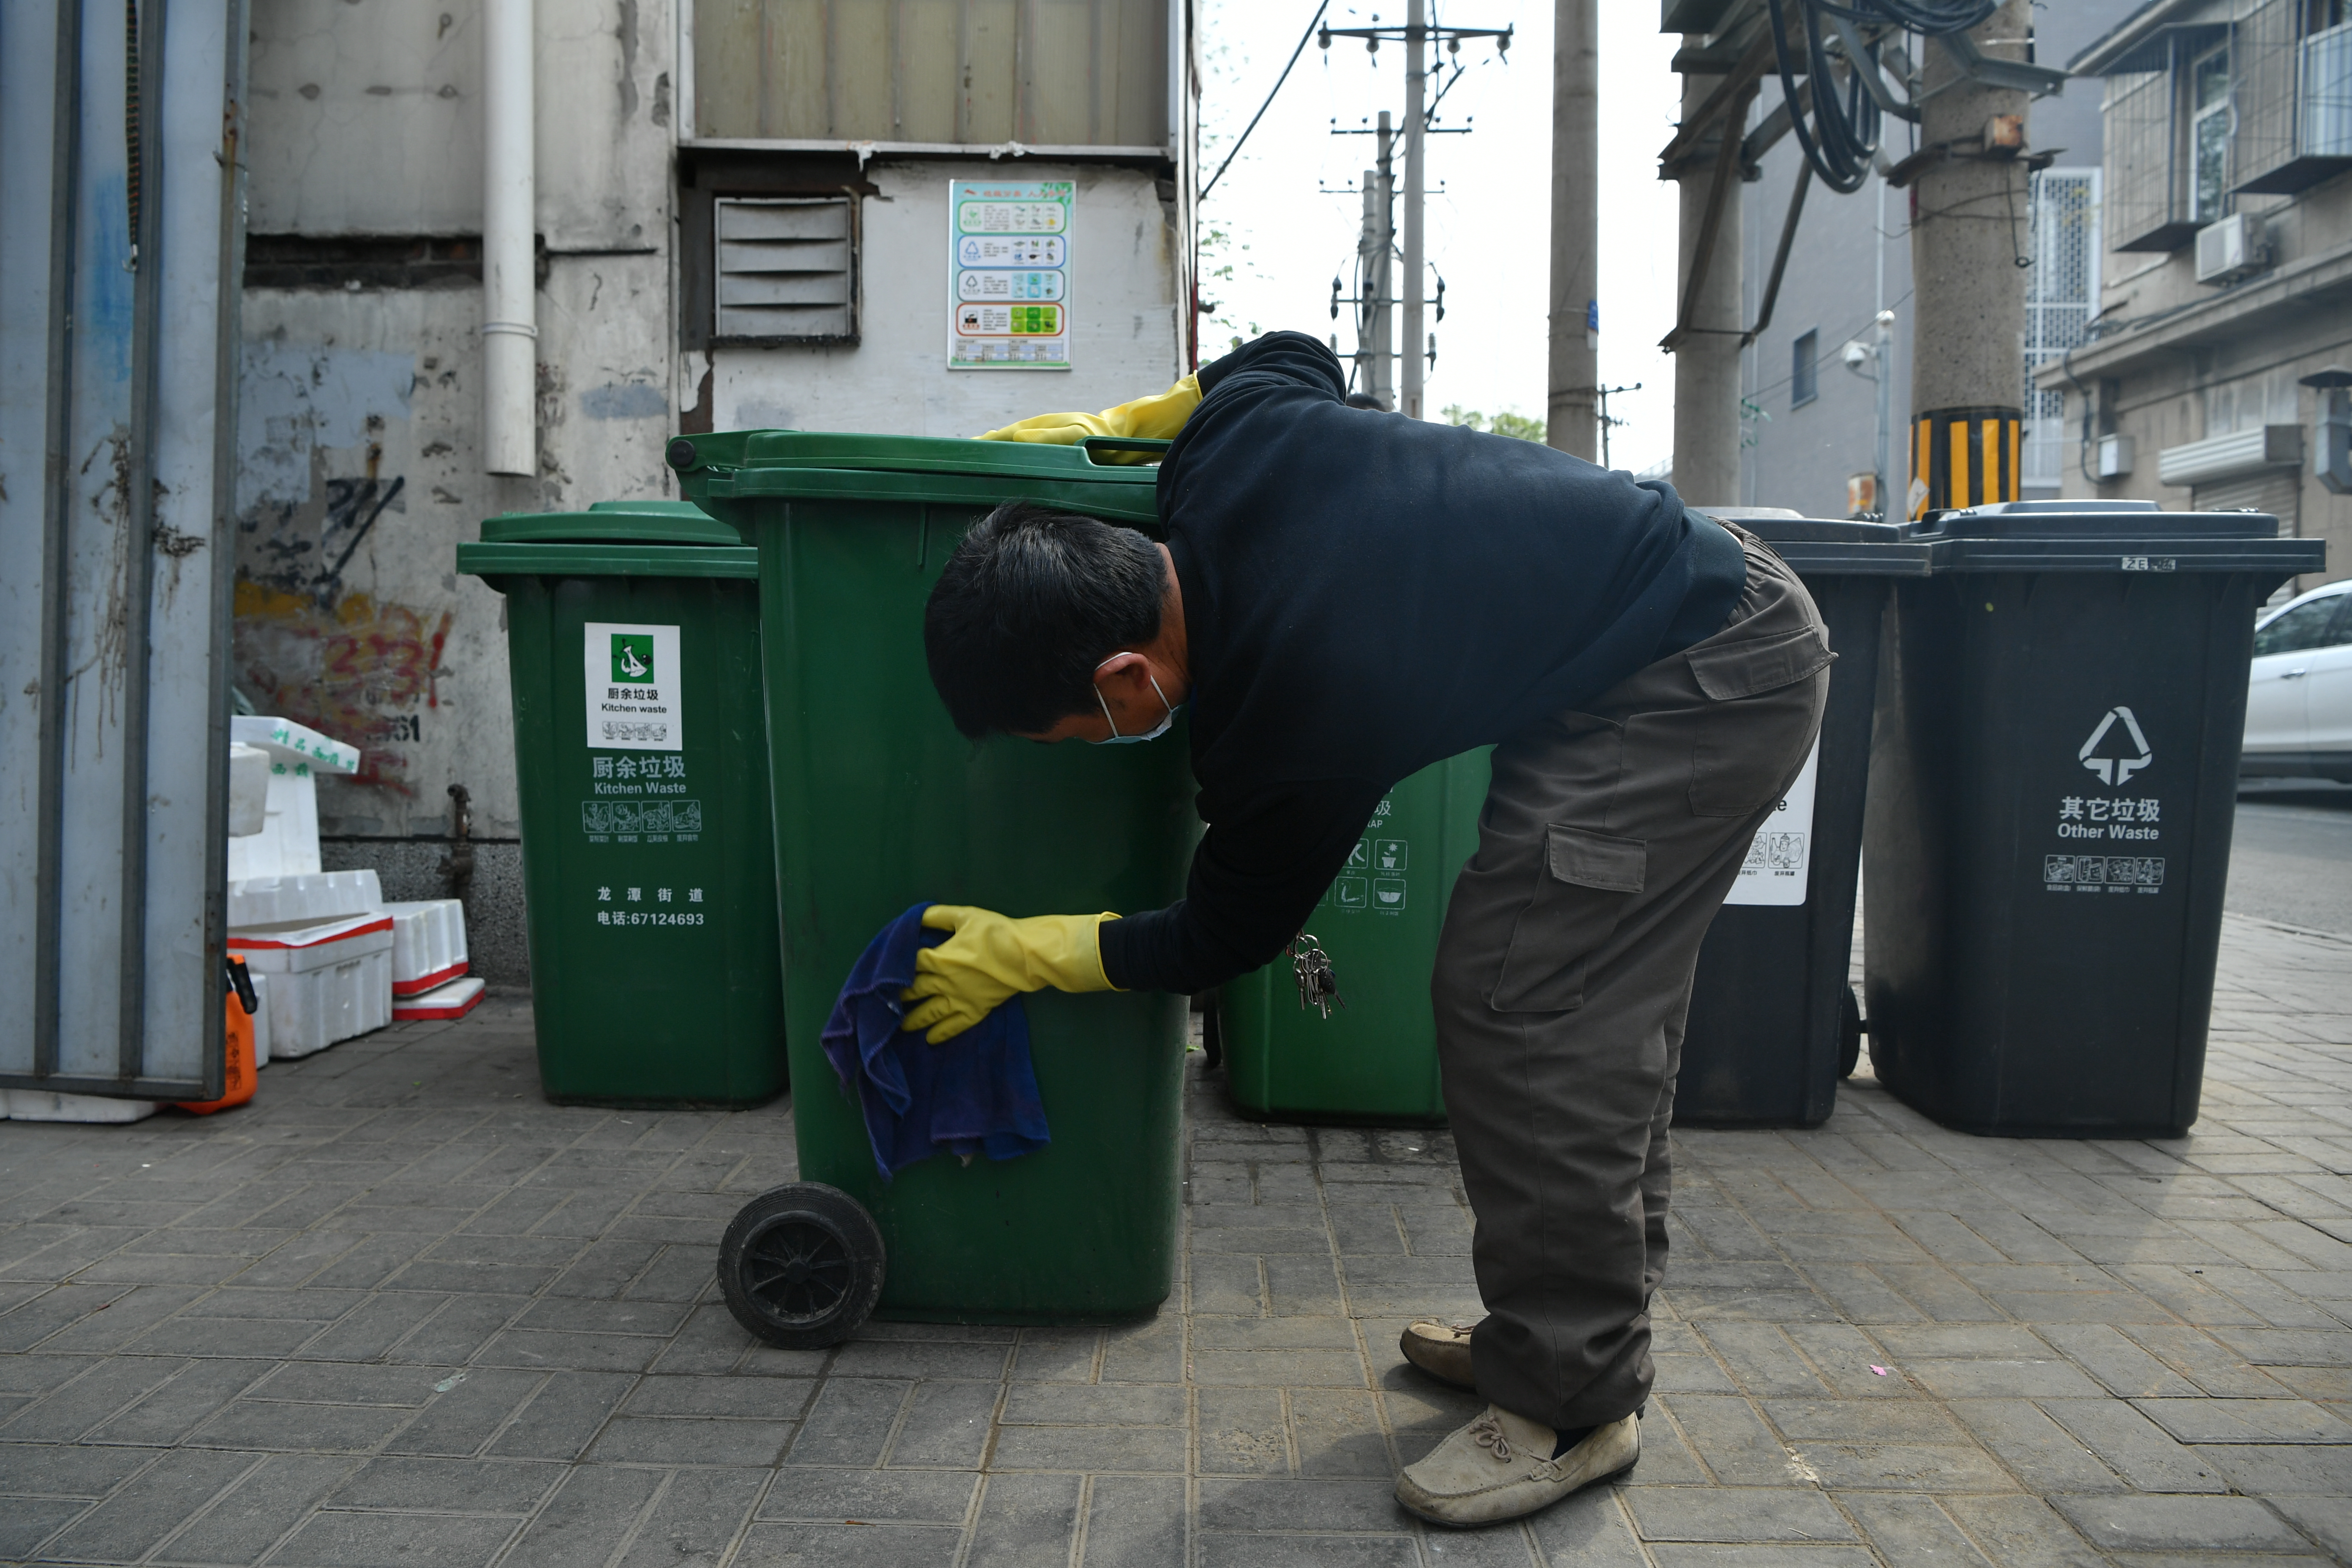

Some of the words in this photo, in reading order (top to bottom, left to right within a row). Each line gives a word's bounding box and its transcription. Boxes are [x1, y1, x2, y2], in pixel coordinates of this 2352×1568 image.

[607, 688, 659, 701] 厨余垃圾
[601, 703, 637, 713] Kitchen
[639, 705, 667, 714] waste
[593, 756, 686, 779] 厨余垃圾
[594, 781, 642, 795] Kitchen
[645, 782, 686, 794] Waste
[2059, 796, 2160, 823] 其它垃圾
[2058, 823, 2104, 839] Other
[2109, 825, 2159, 840] Waste
[597, 886, 704, 903] 龙潭街道
[597, 911, 704, 927] 电话:67124693
